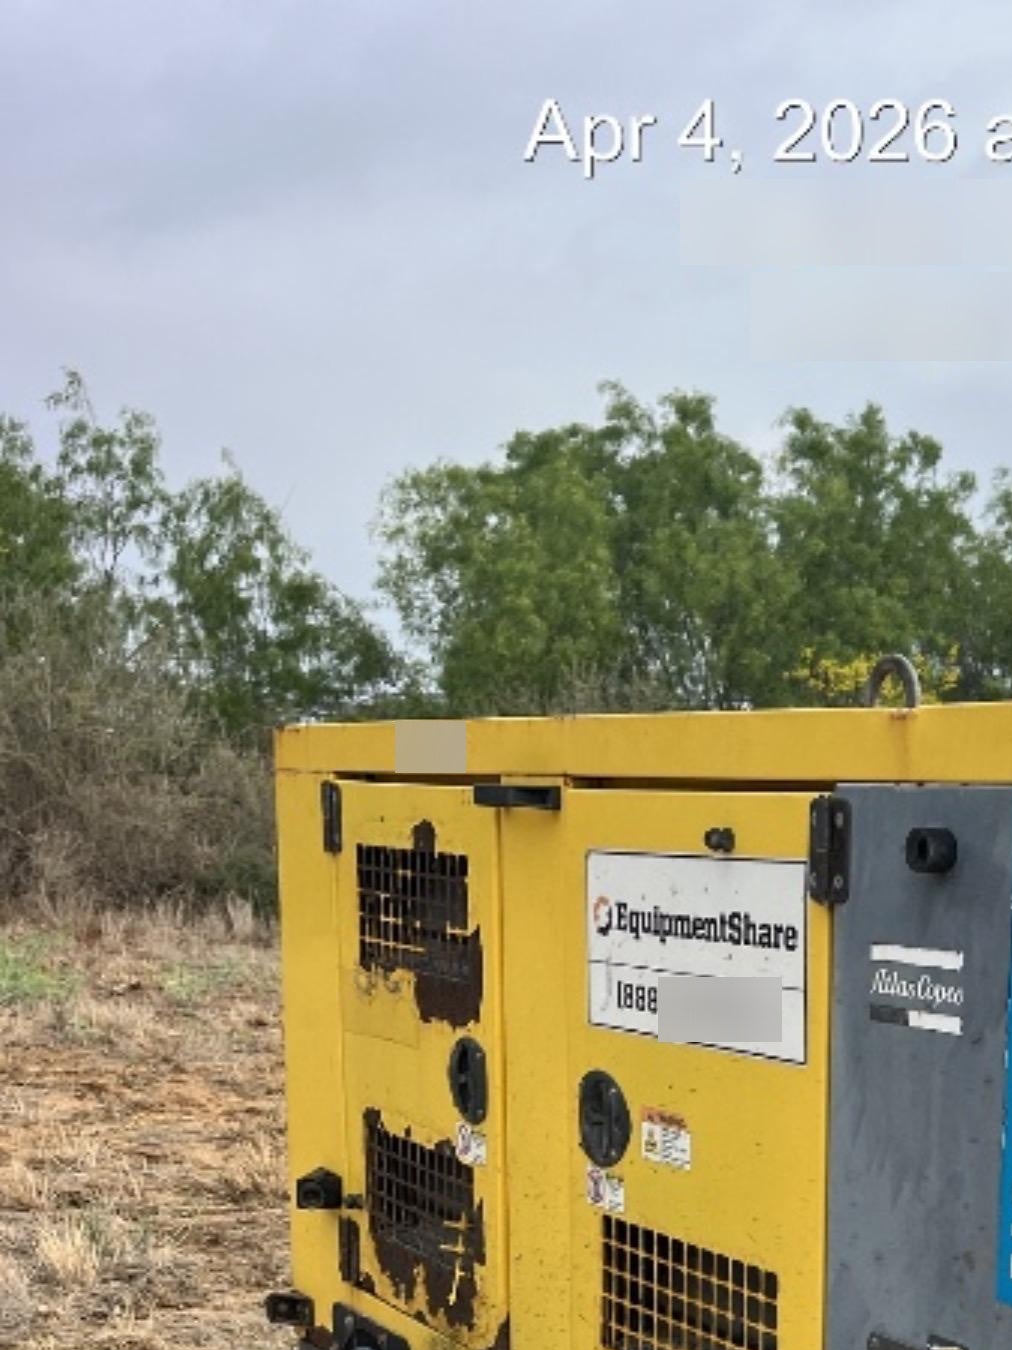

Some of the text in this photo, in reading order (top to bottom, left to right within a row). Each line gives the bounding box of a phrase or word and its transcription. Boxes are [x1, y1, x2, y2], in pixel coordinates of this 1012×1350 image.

[614, 901, 799, 952] EquipmentShare
[869, 968, 964, 1009] Atlas Copco
